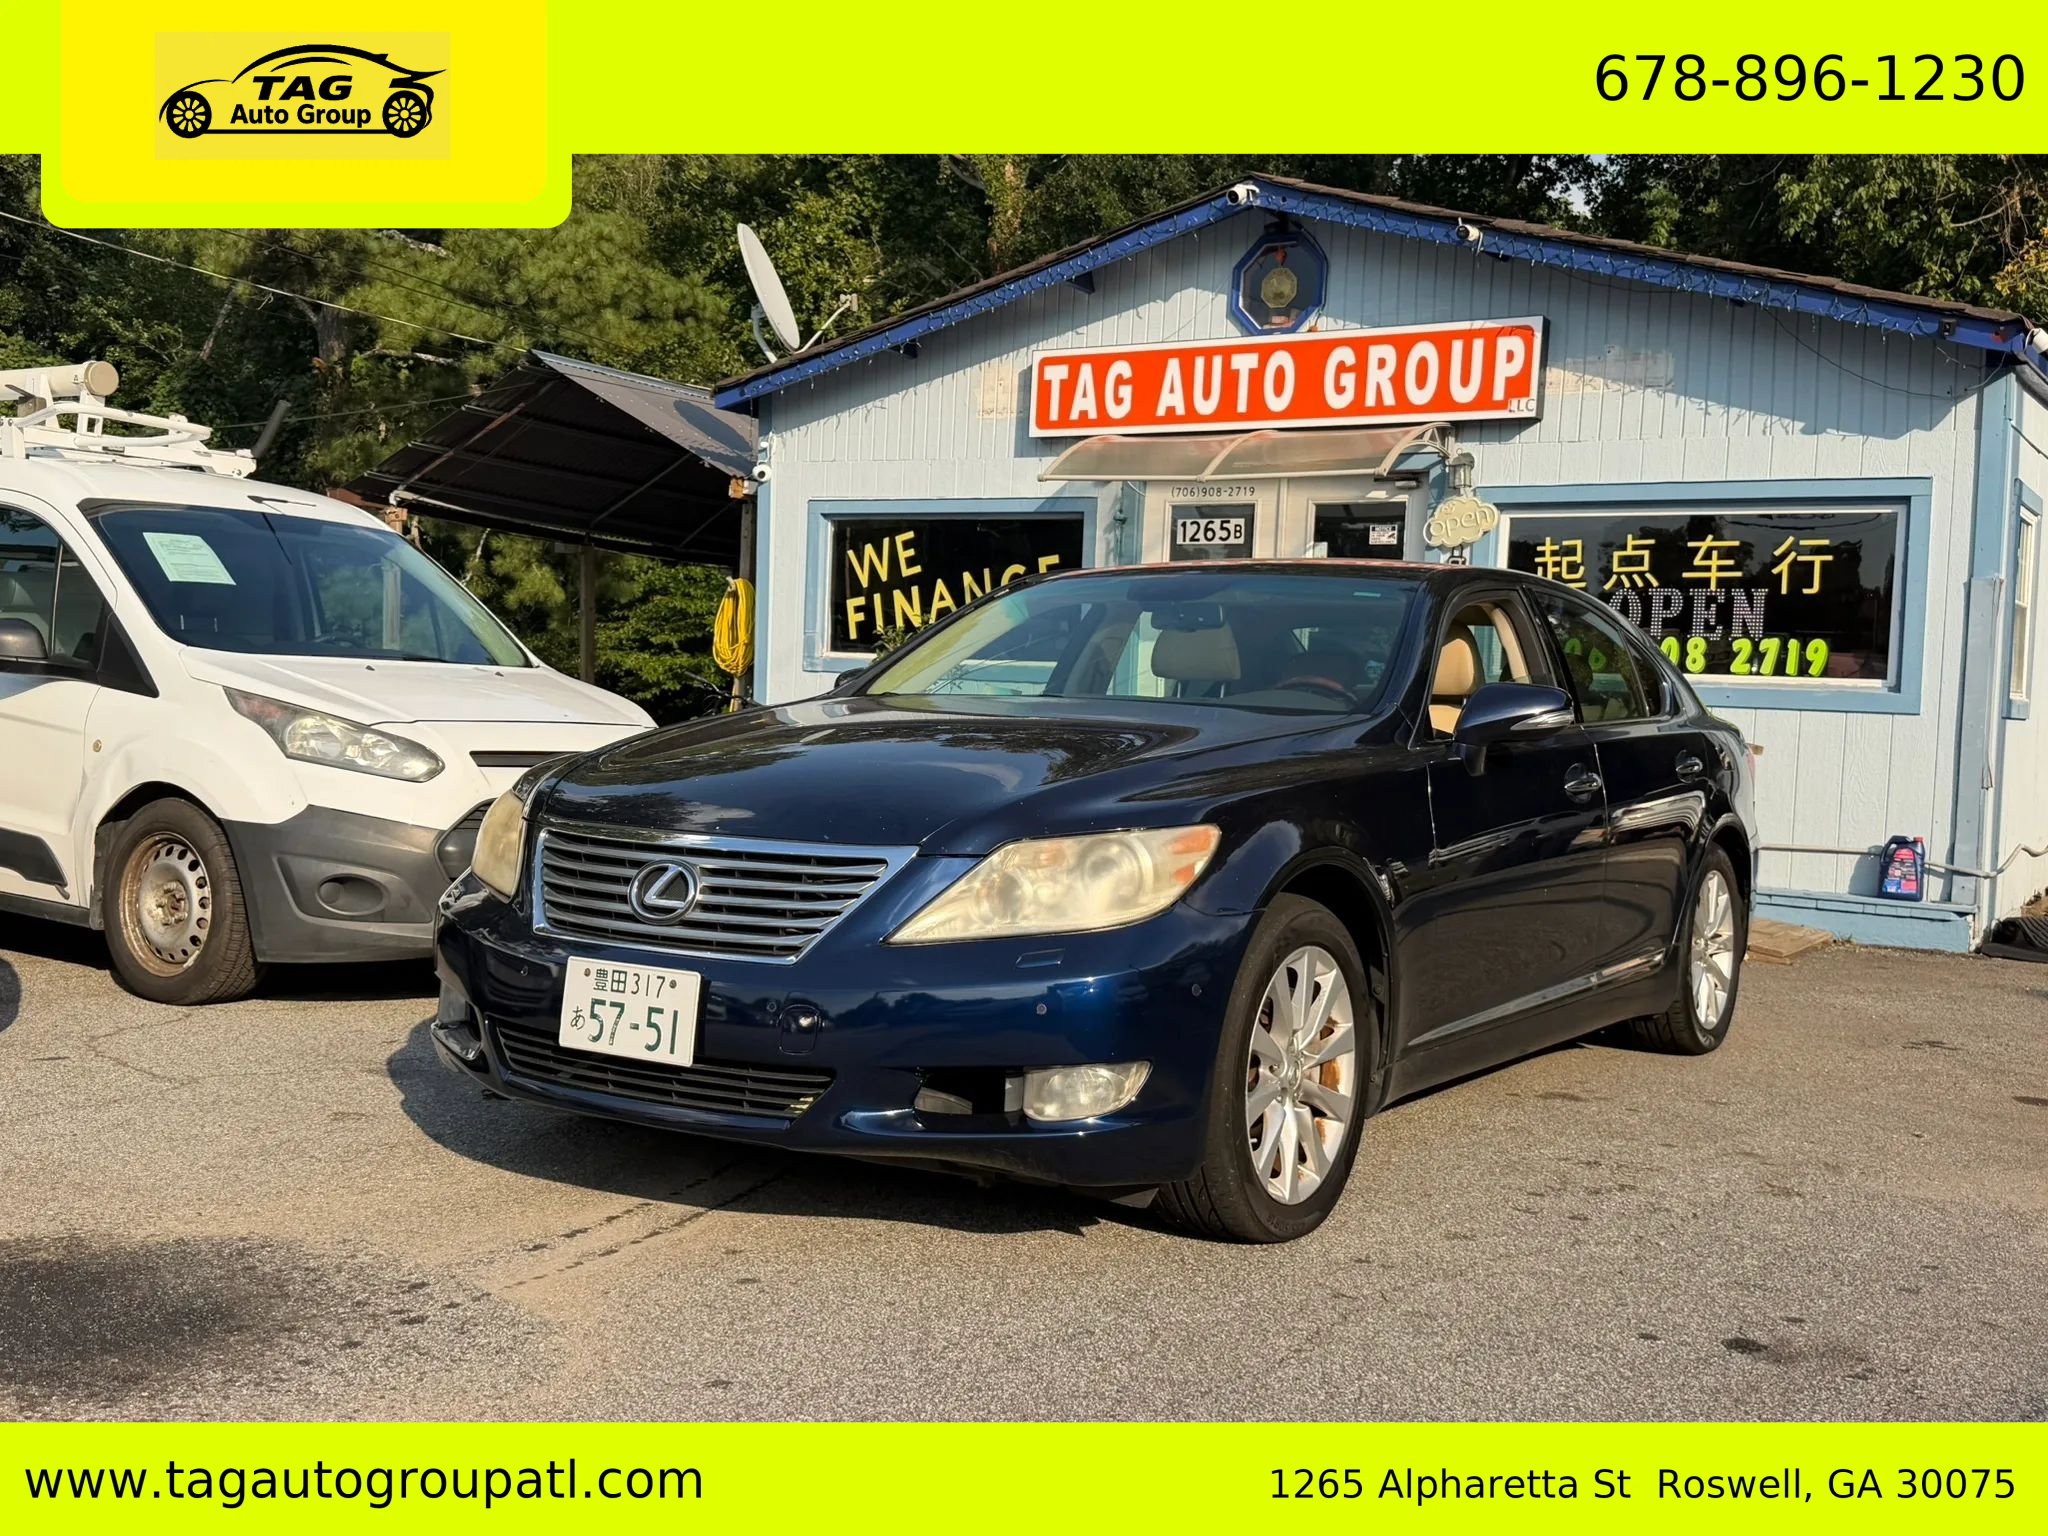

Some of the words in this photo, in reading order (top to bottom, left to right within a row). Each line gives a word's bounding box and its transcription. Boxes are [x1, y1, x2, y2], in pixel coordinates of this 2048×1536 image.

[1043, 360, 1134, 421] TAG
[1155, 350, 1296, 417] AUTO
[1323, 335, 1526, 411] GROUP
[1508, 399, 1536, 412] LLC
[1171, 486, 1256, 498] (706)908-2719
[847, 530, 922, 588] WE
[1608, 588, 1768, 642] OPEN
[1660, 636, 1707, 674] 08
[1730, 638, 1829, 677] 2719
[587, 997, 679, 1055] 57-51
